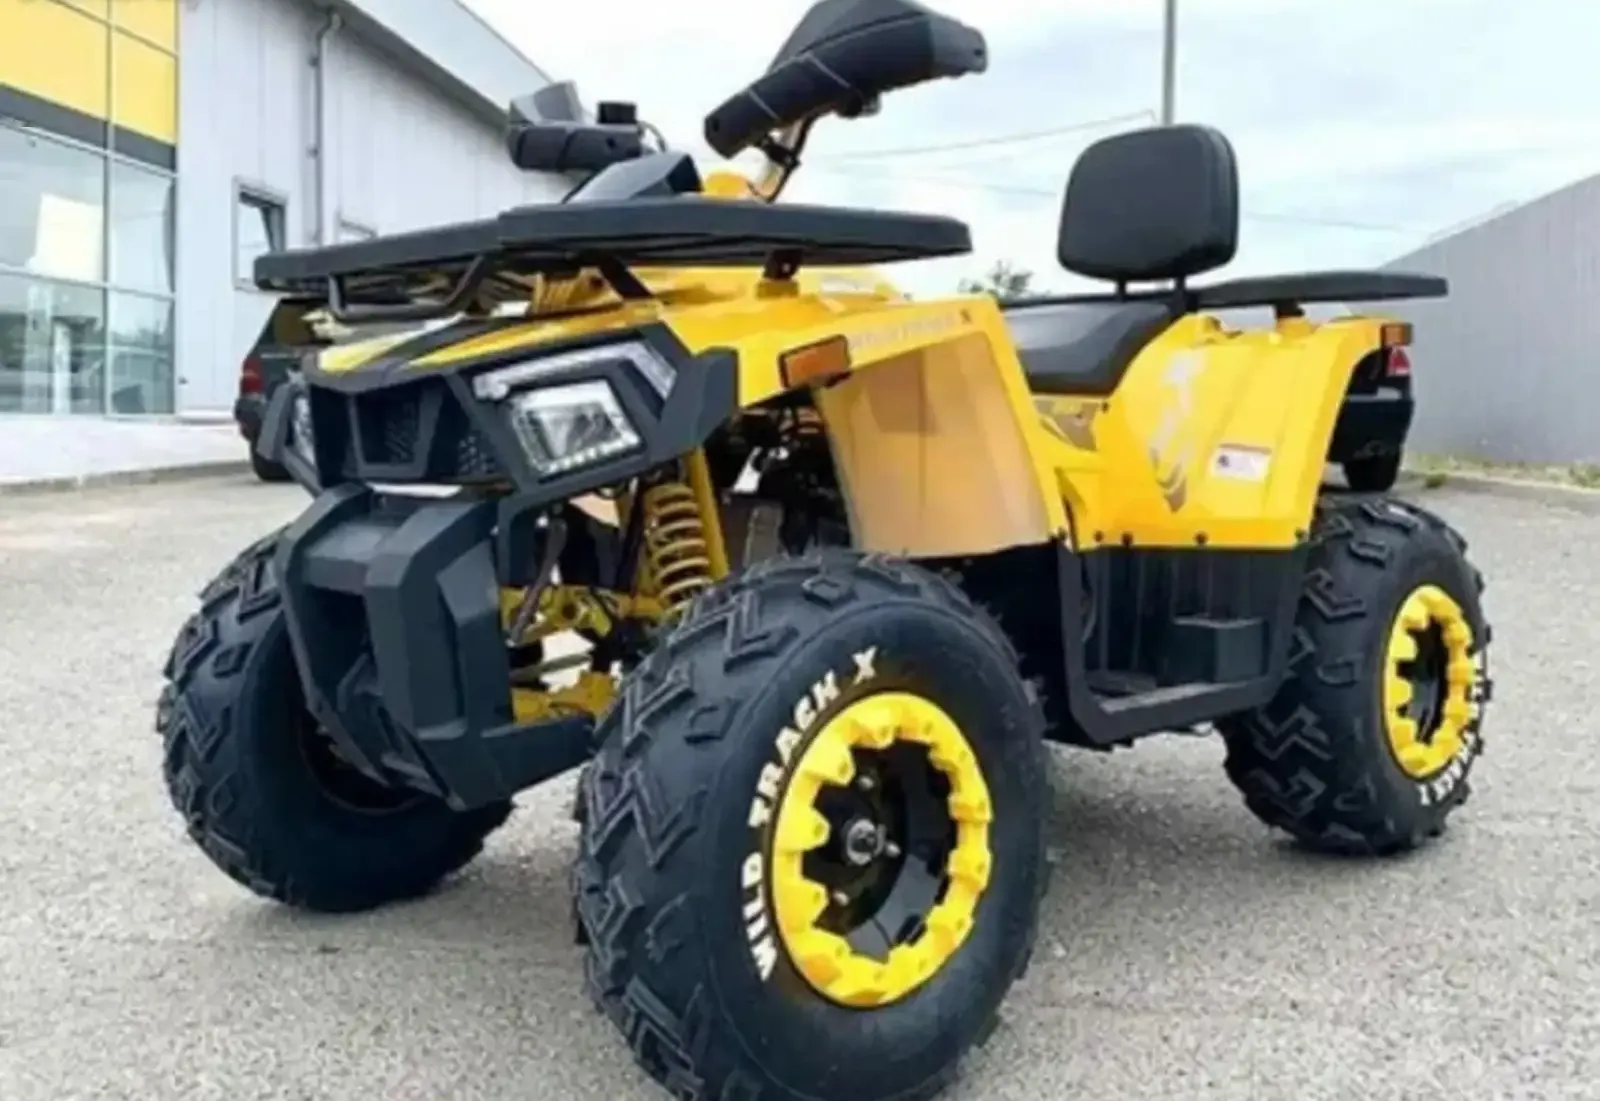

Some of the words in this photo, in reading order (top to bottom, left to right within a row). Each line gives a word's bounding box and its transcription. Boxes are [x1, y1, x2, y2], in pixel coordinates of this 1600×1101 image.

[852, 645, 878, 684] X
[747, 669, 840, 828] TRACK
[742, 851, 777, 982] WILD
